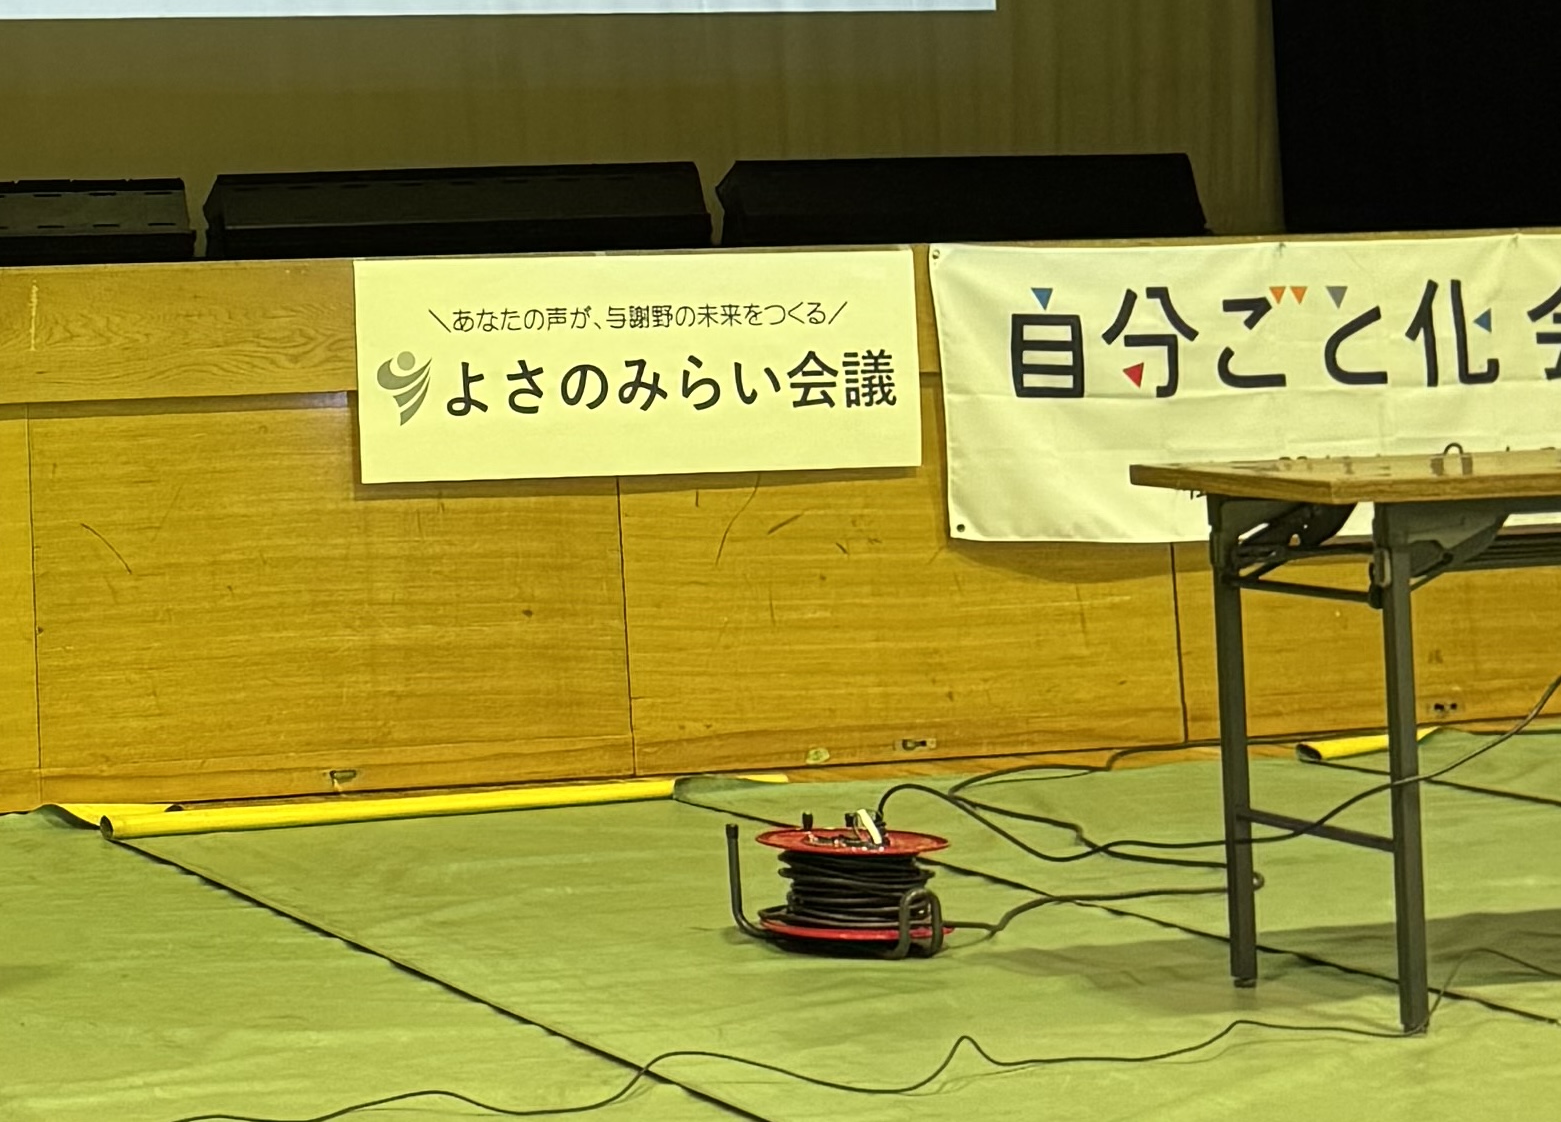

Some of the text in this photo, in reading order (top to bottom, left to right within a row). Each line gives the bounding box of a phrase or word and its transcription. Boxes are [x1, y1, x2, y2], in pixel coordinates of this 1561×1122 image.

[445, 349, 898, 417] よさのみらい会議
